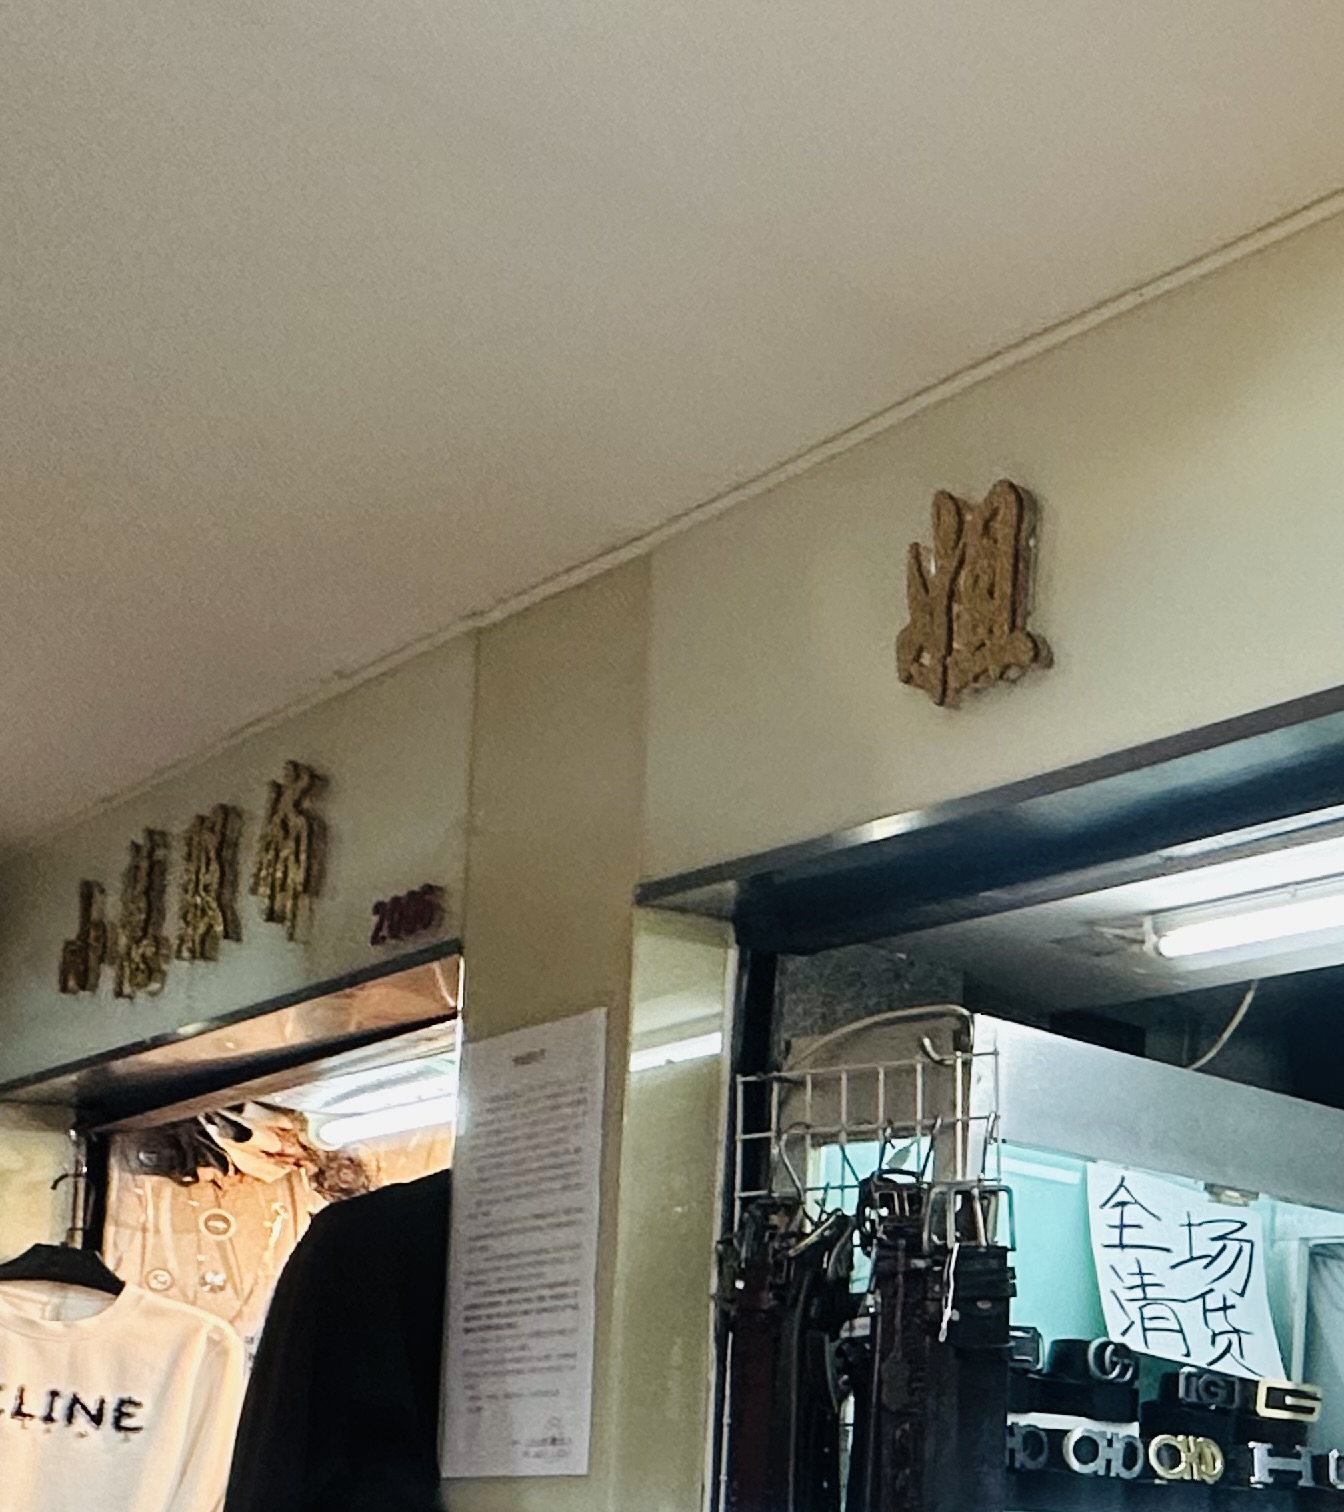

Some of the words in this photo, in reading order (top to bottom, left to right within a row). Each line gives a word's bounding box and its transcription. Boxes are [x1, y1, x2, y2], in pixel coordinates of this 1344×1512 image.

[1099, 1175, 1255, 1298] 全场
[1109, 1257, 1264, 1378] 清货
[0, 1383, 143, 1433] LINE
